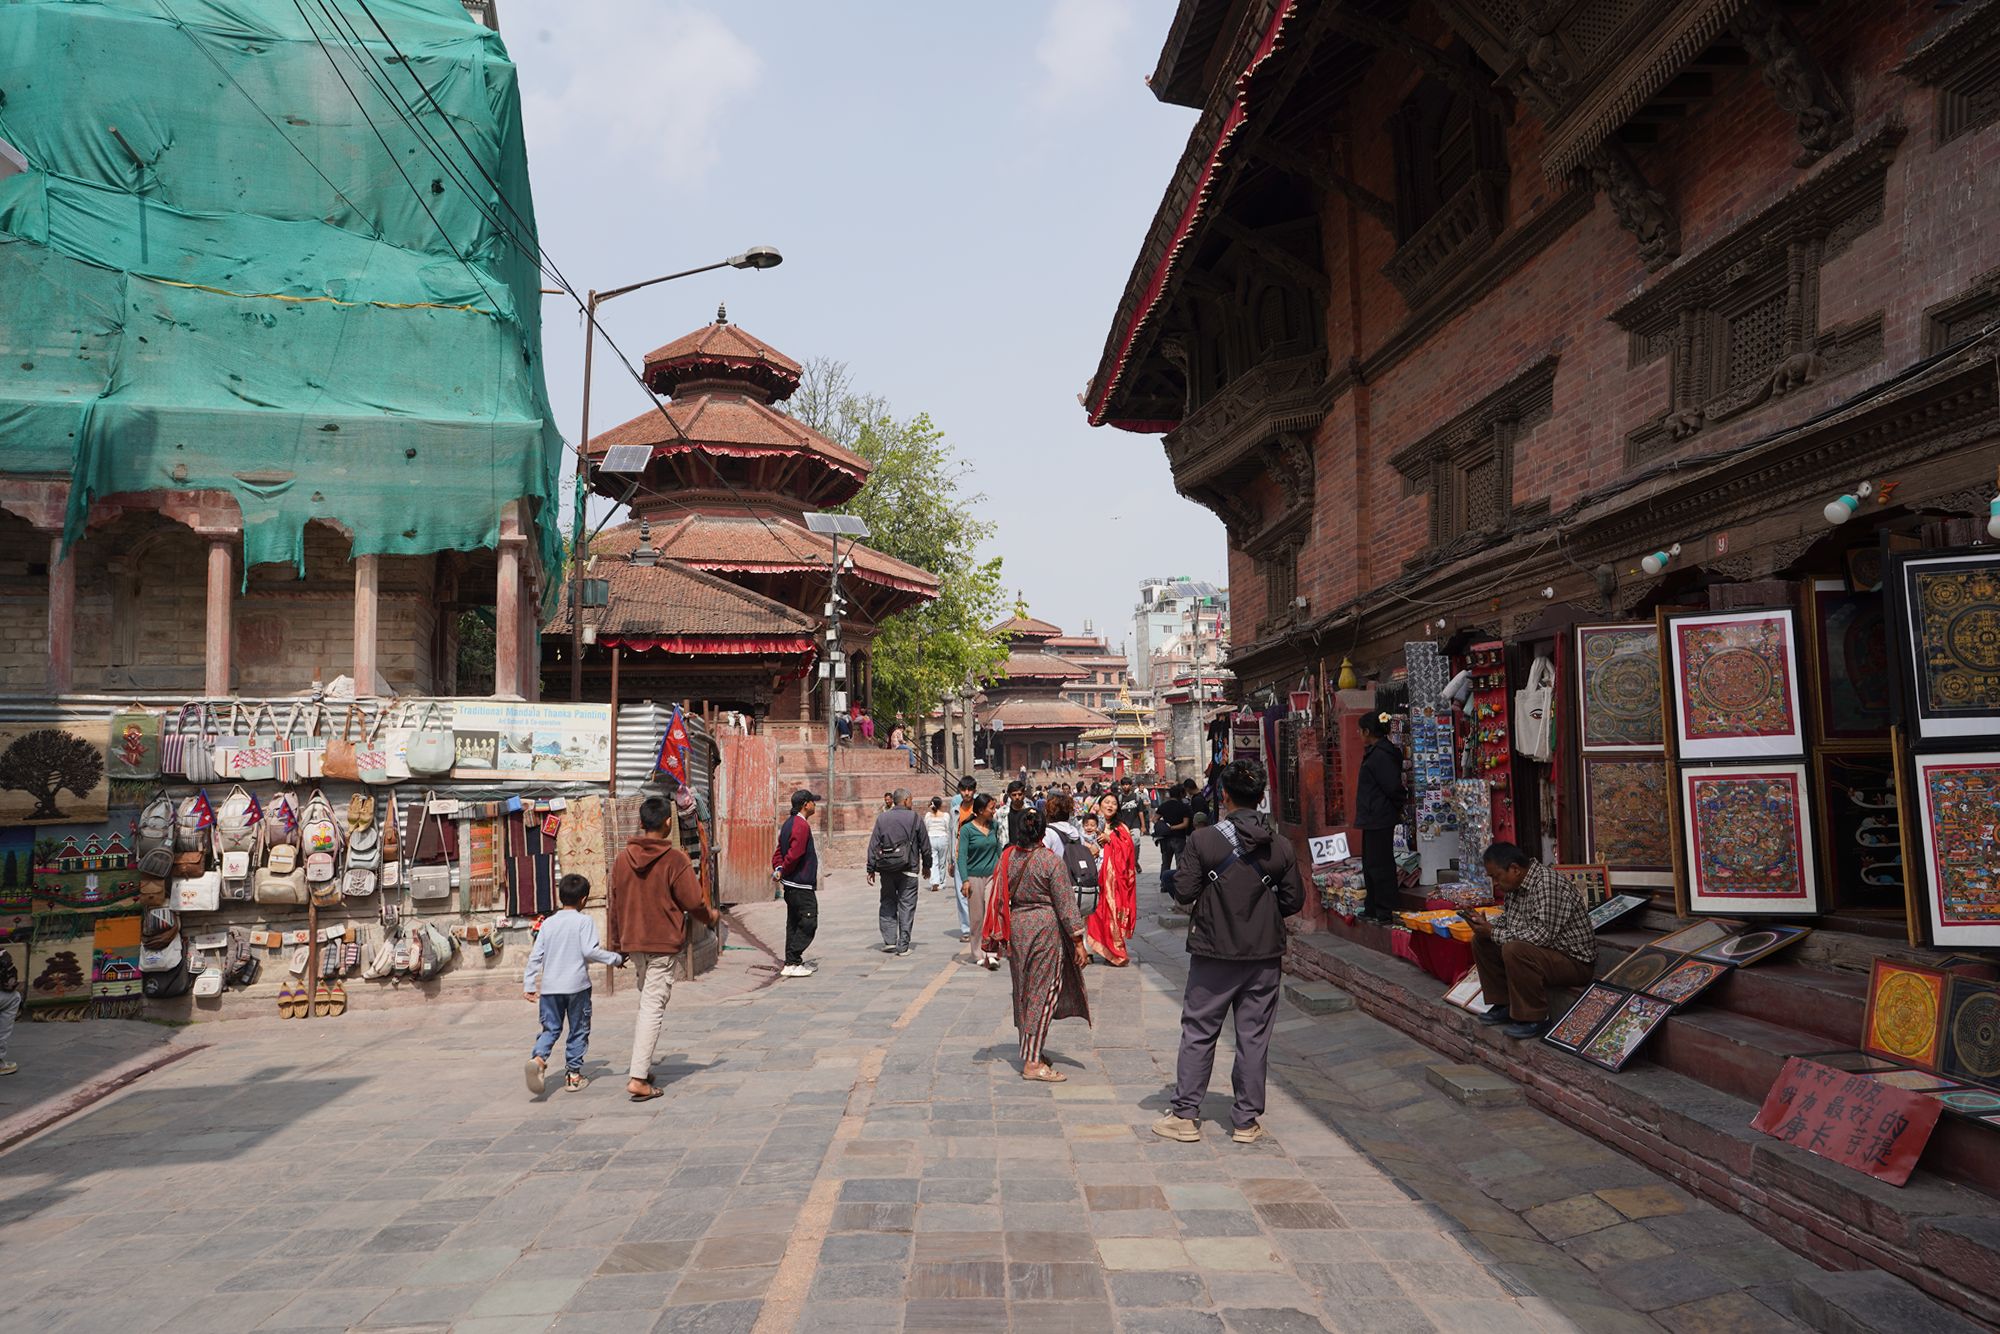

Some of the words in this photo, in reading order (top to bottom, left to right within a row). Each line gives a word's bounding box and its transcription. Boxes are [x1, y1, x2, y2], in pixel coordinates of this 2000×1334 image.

[459, 705, 503, 717] Traditional
[506, 706, 541, 718] Mandala
[574, 709, 607, 721] Painting
[1314, 837, 1347, 858] 250
[1781, 1086, 1909, 1140] 我有最好的
